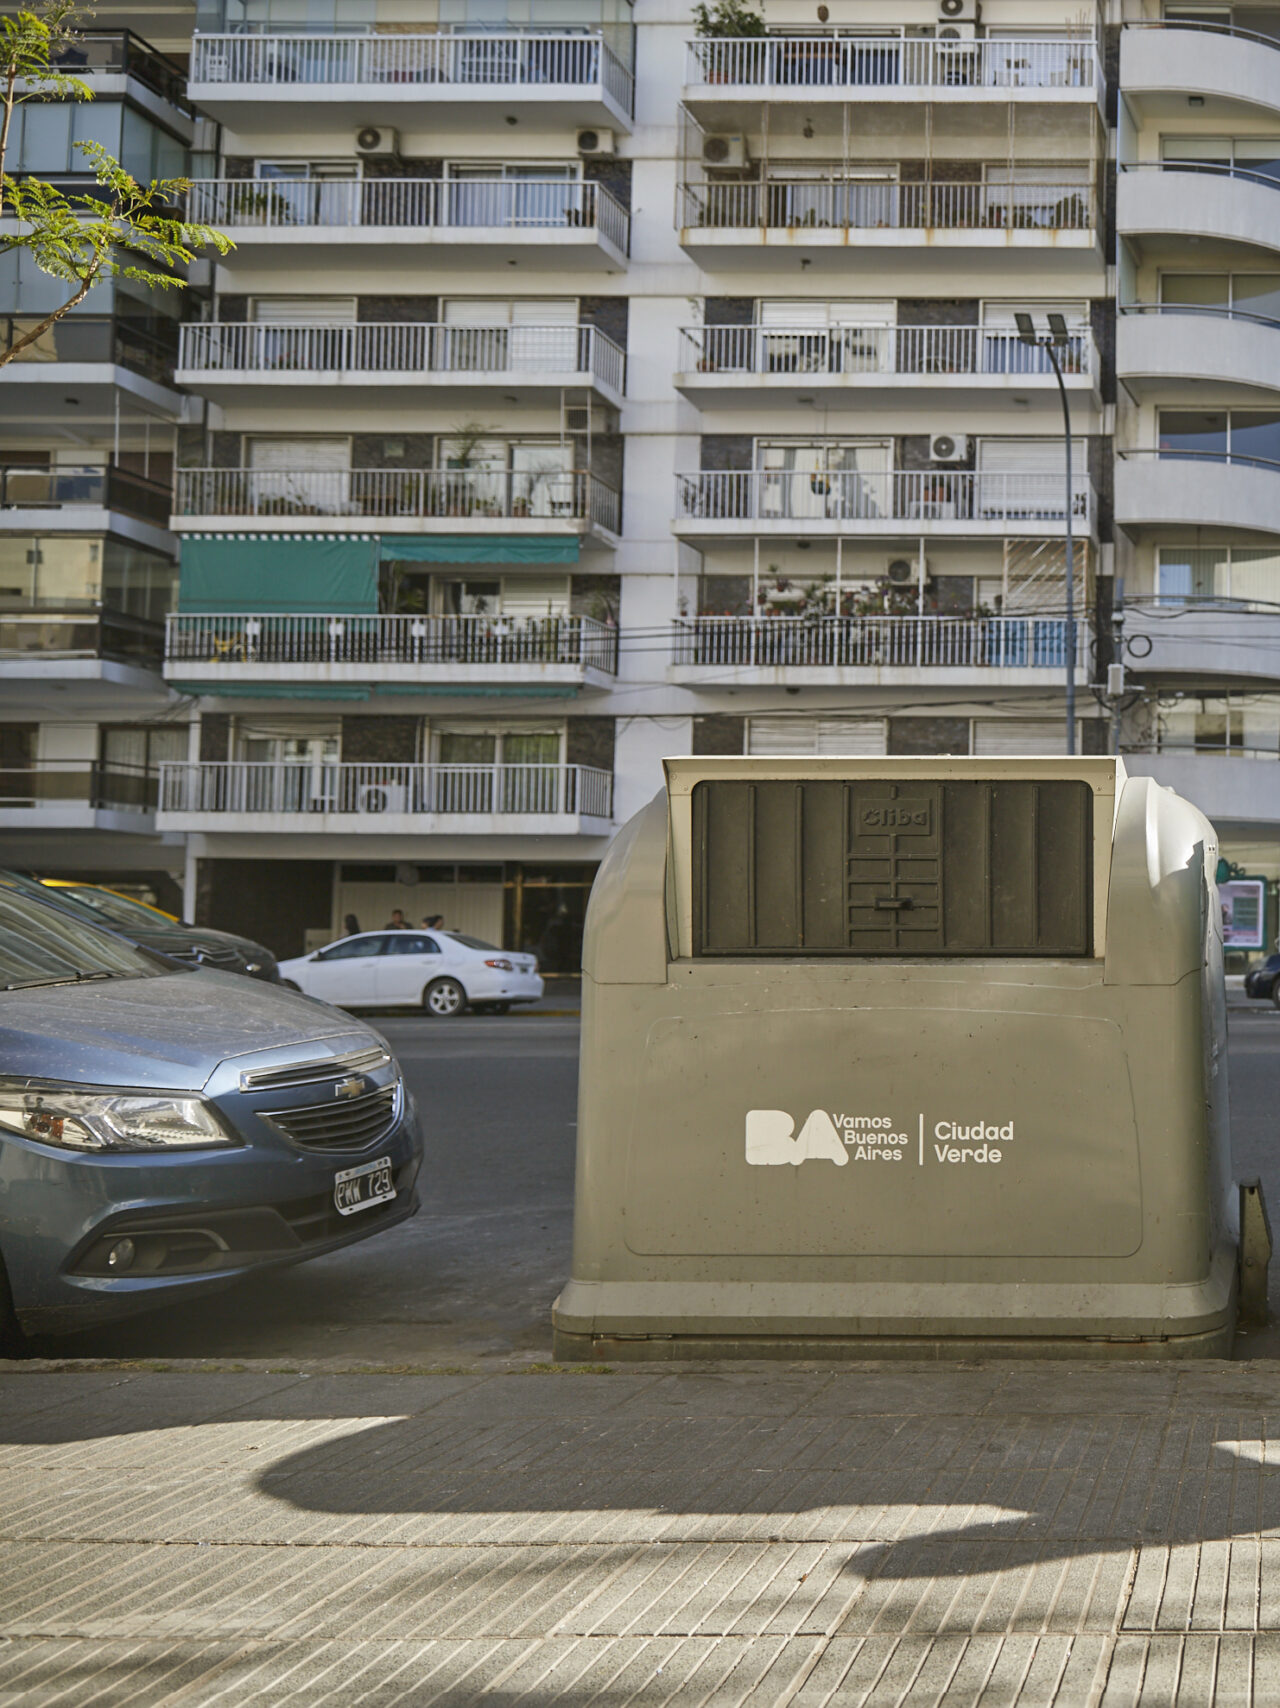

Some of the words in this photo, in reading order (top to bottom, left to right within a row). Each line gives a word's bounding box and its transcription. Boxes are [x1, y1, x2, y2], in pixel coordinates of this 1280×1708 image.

[864, 808, 928, 826] Cliba
[833, 1113, 892, 1129] Vamos
[746, 1109, 849, 1166] BA
[844, 1129, 908, 1145] Buenos
[934, 1121, 1014, 1141] Ciudad
[854, 1145, 903, 1161] Aires
[934, 1144, 1002, 1164] Verde
[368, 1168, 391, 1196] 729
